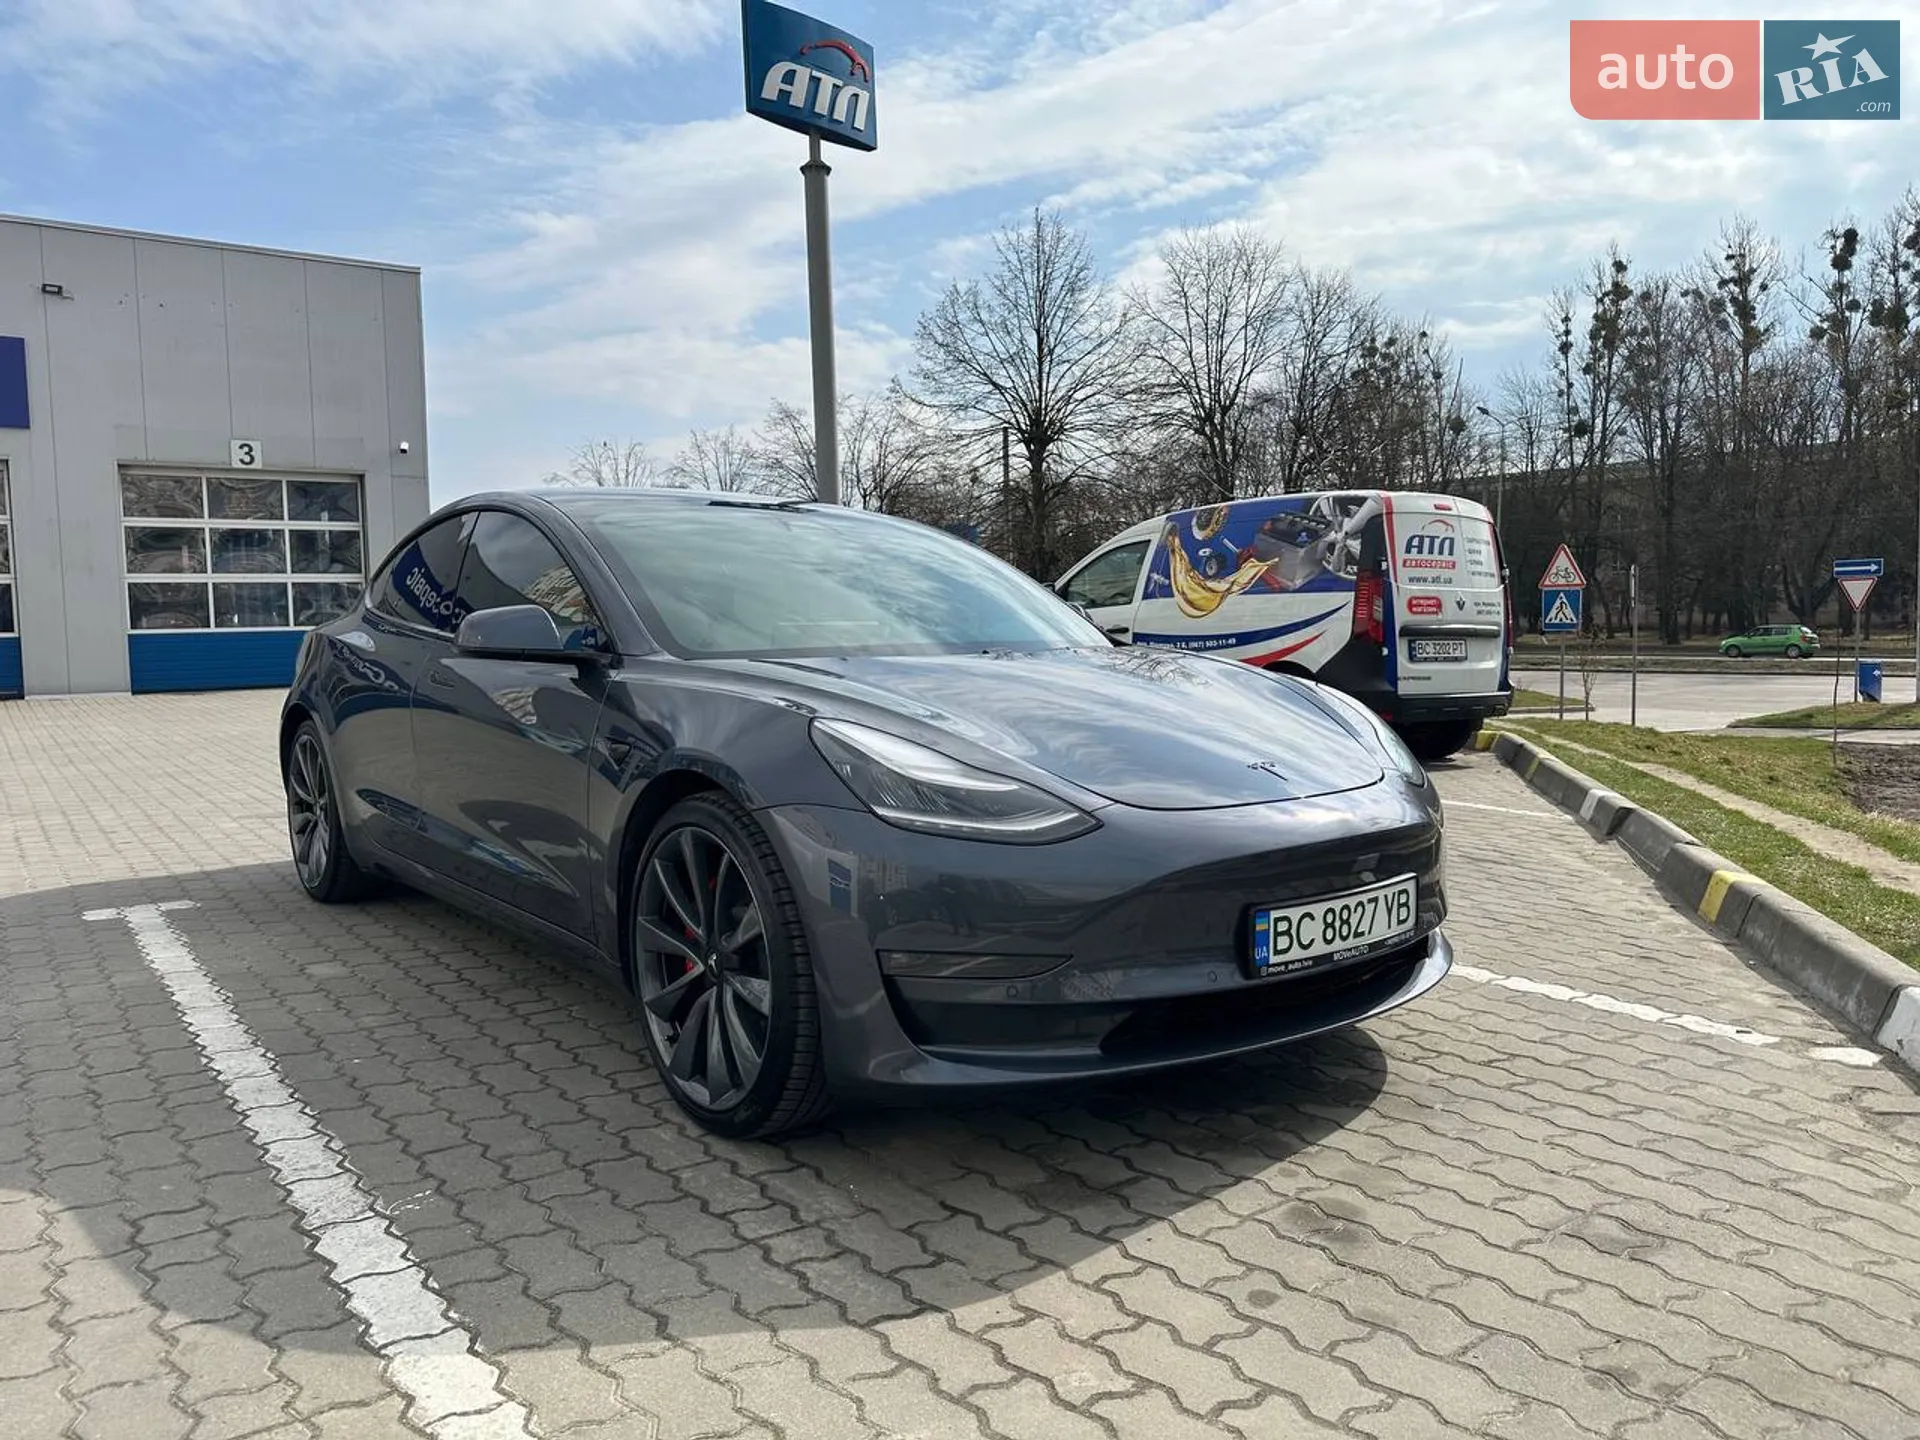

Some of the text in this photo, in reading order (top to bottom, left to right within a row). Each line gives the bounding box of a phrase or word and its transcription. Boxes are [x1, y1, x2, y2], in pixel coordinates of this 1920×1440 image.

[238, 443, 255, 466] 3
[1417, 641, 1431, 655] BC
[1273, 888, 1410, 956] BC 8827 YB
[1255, 945, 1268, 960] UA
